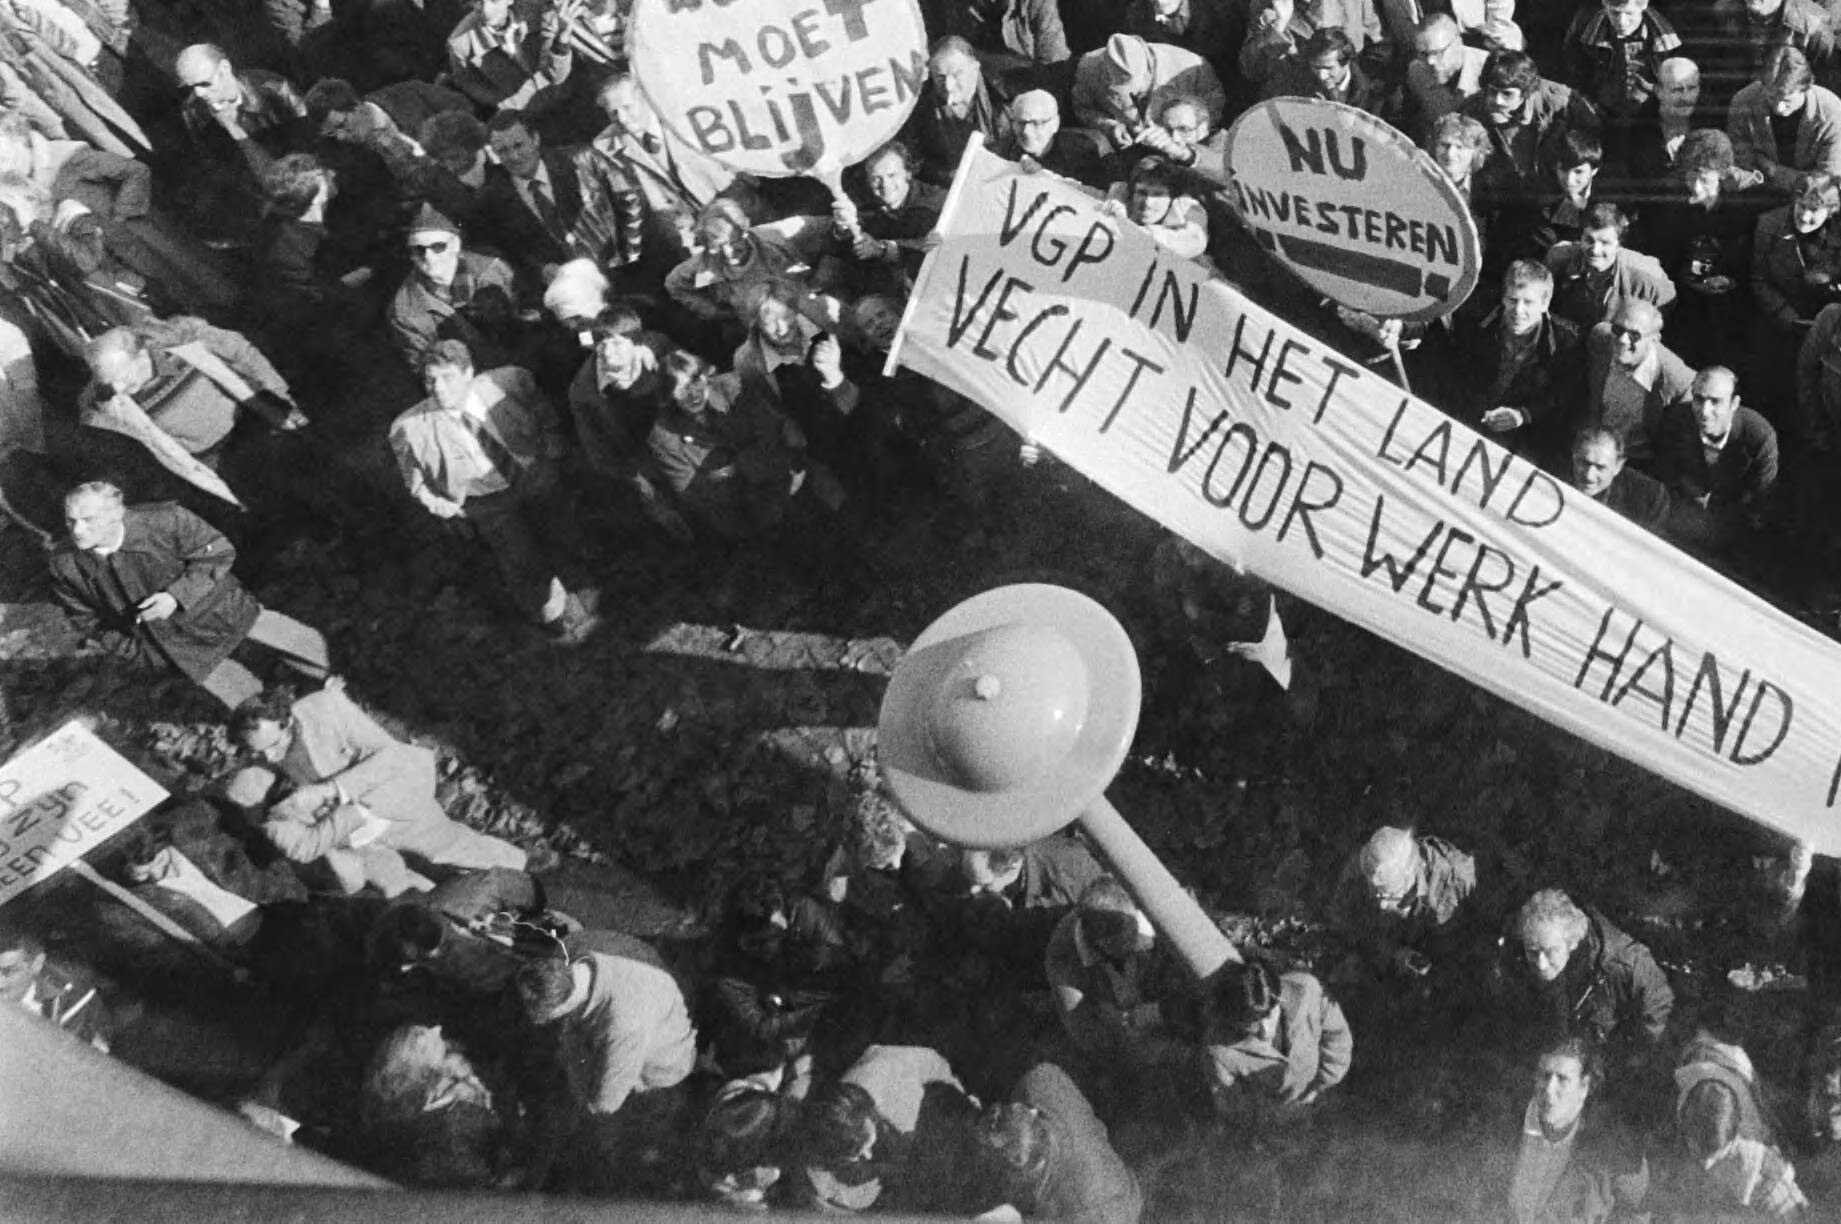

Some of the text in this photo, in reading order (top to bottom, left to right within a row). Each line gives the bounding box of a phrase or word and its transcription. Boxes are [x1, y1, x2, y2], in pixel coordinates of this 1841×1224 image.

[1233, 179, 1459, 266] INVESTEREN
[1278, 126, 1367, 182] NU
[999, 178, 1564, 528] VGP IN HET LAND
[946, 255, 1165, 434] VECHT
[1167, 386, 1344, 558] VOOR
[1360, 494, 1563, 659] WERK
[1575, 607, 1793, 767] HAND
